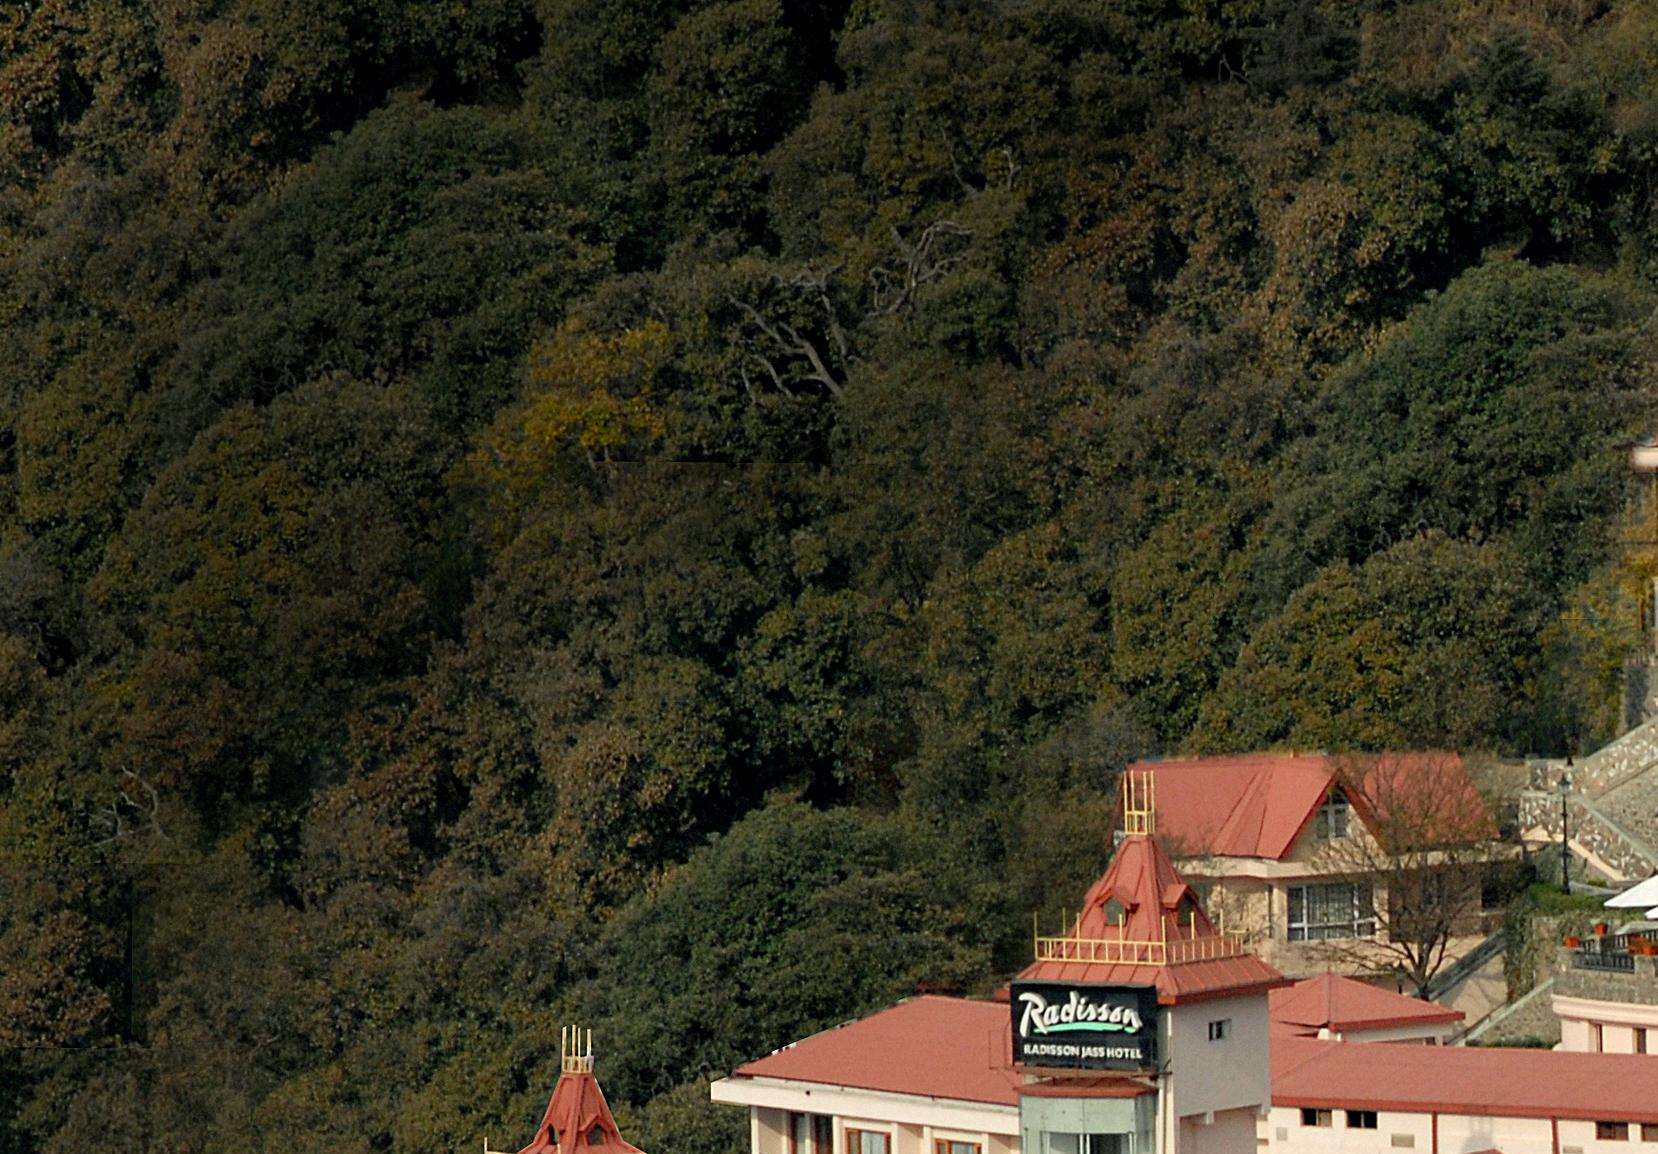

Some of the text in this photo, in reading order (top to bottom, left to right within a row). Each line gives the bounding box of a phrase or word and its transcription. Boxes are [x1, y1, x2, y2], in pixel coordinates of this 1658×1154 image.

[1019, 991, 1143, 1037] Radisson
[1024, 1044, 1143, 1059] RADISSON JASS HOTEL
